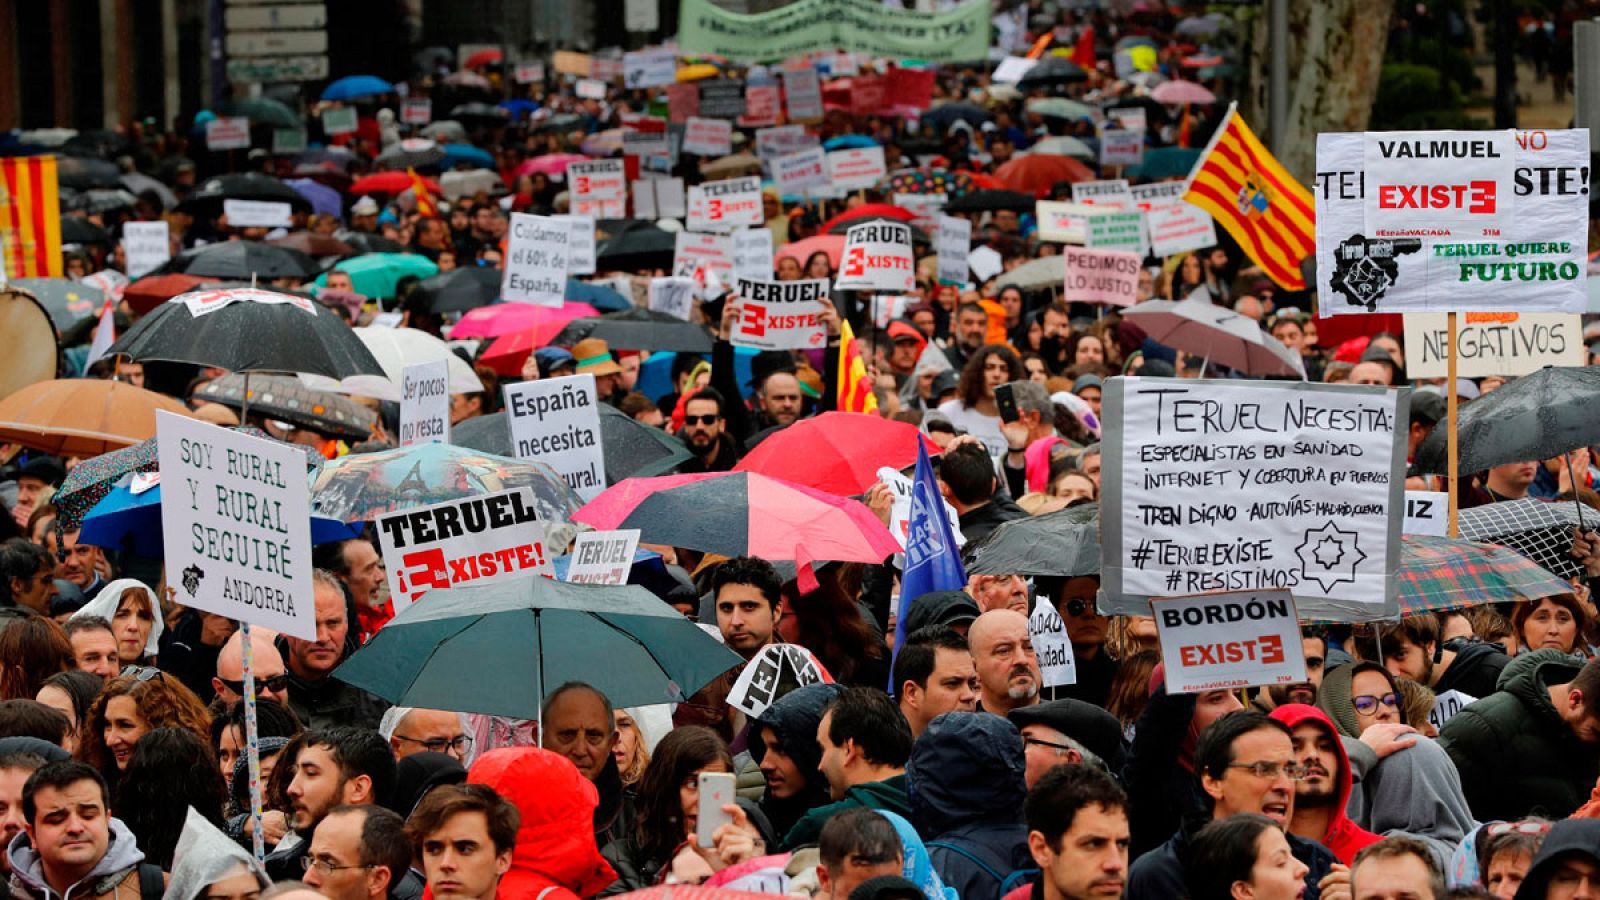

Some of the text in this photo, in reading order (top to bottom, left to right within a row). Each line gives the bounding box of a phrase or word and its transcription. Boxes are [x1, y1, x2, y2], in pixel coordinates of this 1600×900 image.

[1379, 141, 1501, 158] VALMUEL
[1514, 167, 1590, 196] STE!
[1379, 181, 1497, 214] EXISTE
[514, 223, 568, 244] Cuidamos
[848, 225, 909, 246] TERUEL
[512, 249, 565, 268] el 60% de
[1433, 242, 1571, 257] TERUEL QUIERE
[1067, 252, 1138, 275] PEDIMOS
[1459, 262, 1580, 282] FUTURO
[738, 278, 826, 303] TERUEL
[1067, 275, 1087, 289] LO
[1423, 323, 1566, 363] NEGATIVOS
[403, 375, 445, 405] Ser pocos
[511, 384, 590, 421] España
[1137, 389, 1393, 436] TERUEL NECESITA:
[402, 415, 444, 440] no resta
[519, 424, 596, 458] necesita
[180, 438, 287, 489] SOY RURAL
[1140, 440, 1364, 463] ESPECIALISTAS EN SANIDAD
[563, 462, 601, 489] ural.
[1144, 468, 1231, 490] INTERNET
[1239, 468, 1251, 489] Y
[1255, 466, 1327, 485] COBERTURA
[1330, 470, 1347, 485] EN
[186, 478, 289, 534] Y RURAL
[381, 491, 537, 548] TERUEL
[1139, 504, 1182, 526] TREN
[1189, 503, 1238, 525] DIGNO
[1407, 500, 1433, 519] IZ
[191, 522, 293, 580] SEGUIRÉ
[577, 538, 629, 565] TERUEL
[1165, 566, 1302, 592] #RESISTIMOS
[223, 575, 297, 617] ANDORRA
[1161, 597, 1289, 629] BORDÓN
[1179, 634, 1285, 668] EXISTE
